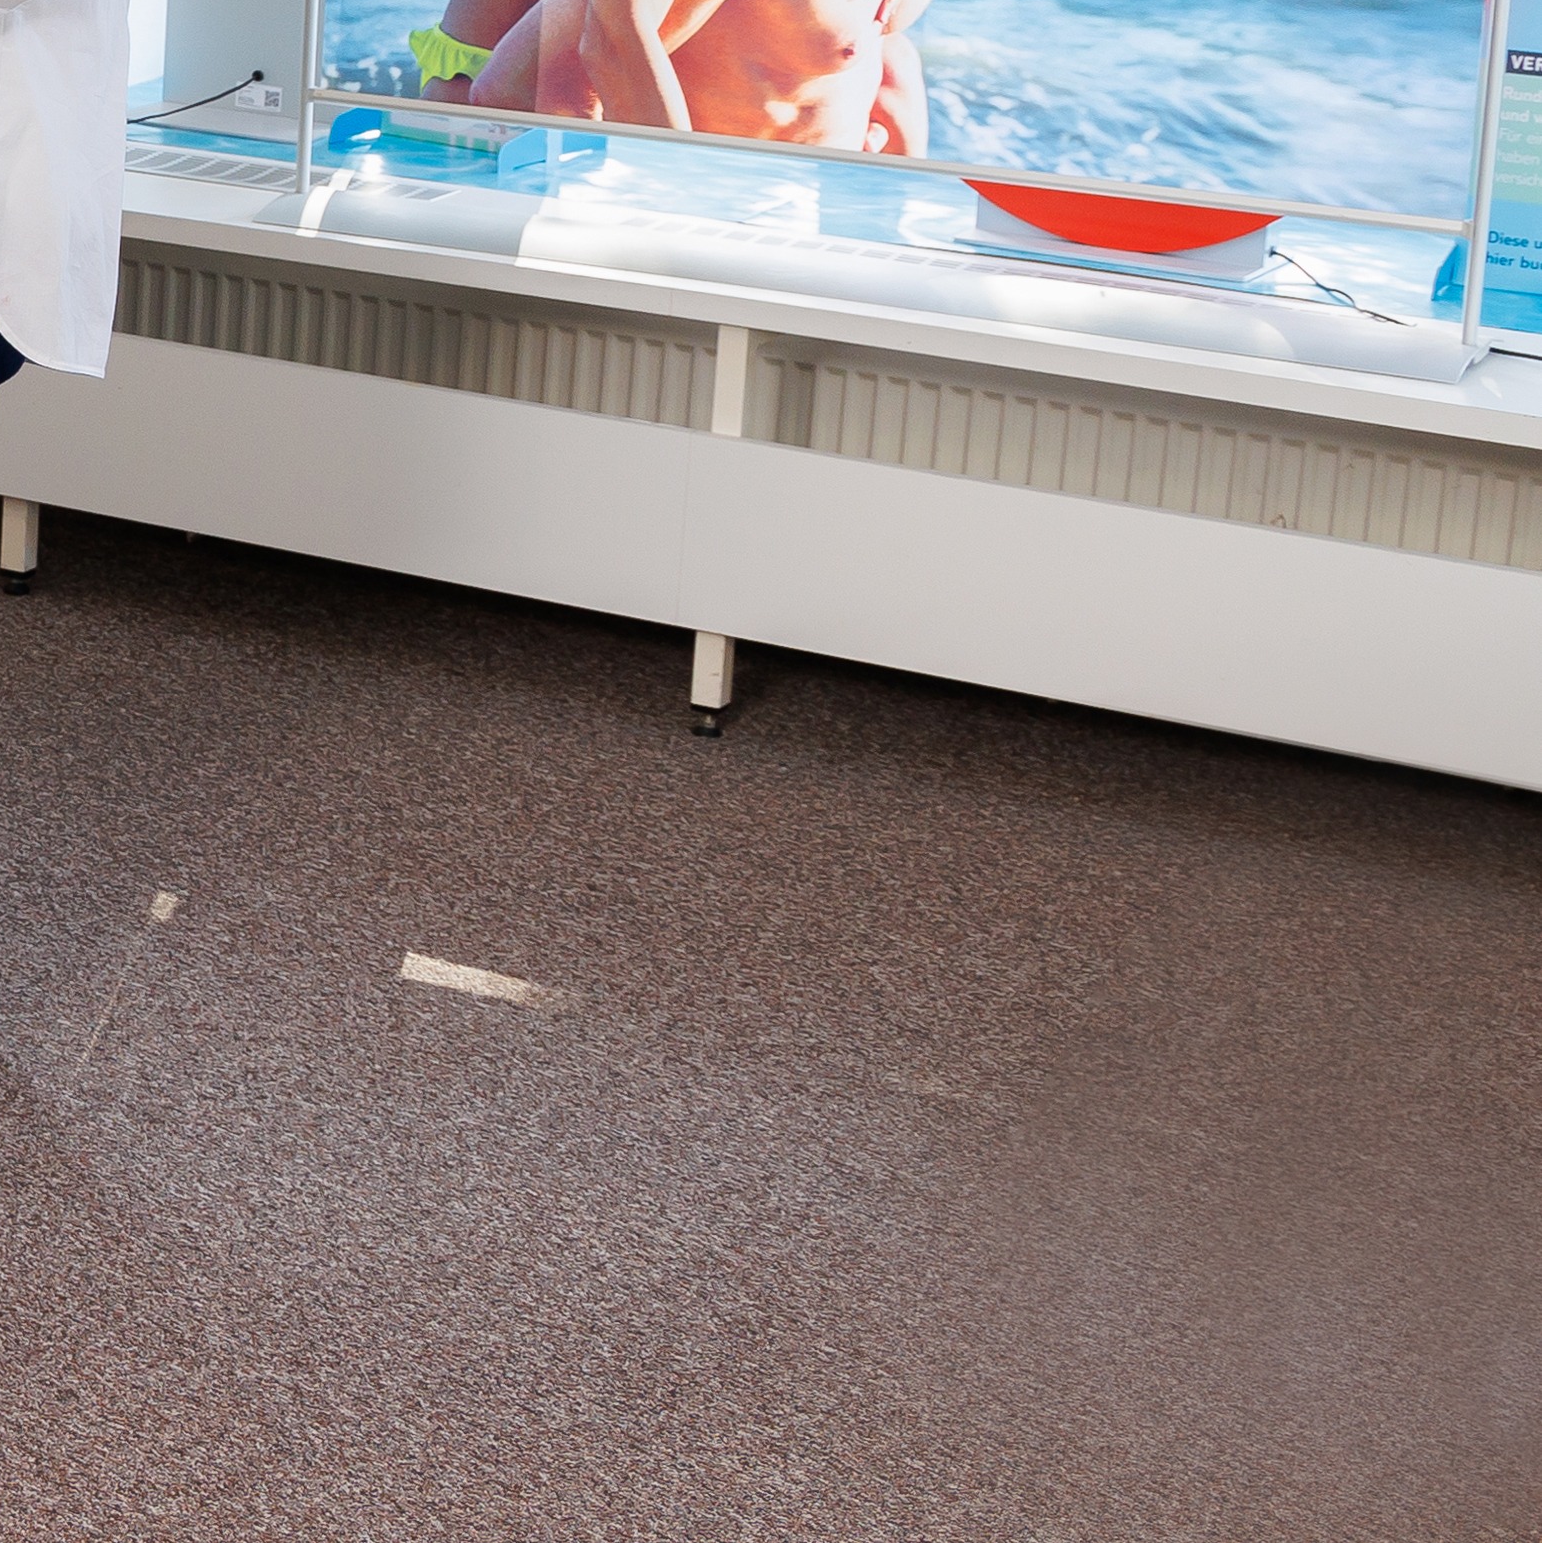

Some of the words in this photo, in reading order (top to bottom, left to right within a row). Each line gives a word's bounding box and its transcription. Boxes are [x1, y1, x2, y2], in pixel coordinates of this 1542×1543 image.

[1487, 230, 1529, 248] Diese
[1486, 251, 1514, 266] hier
[1520, 256, 1542, 270] bu
